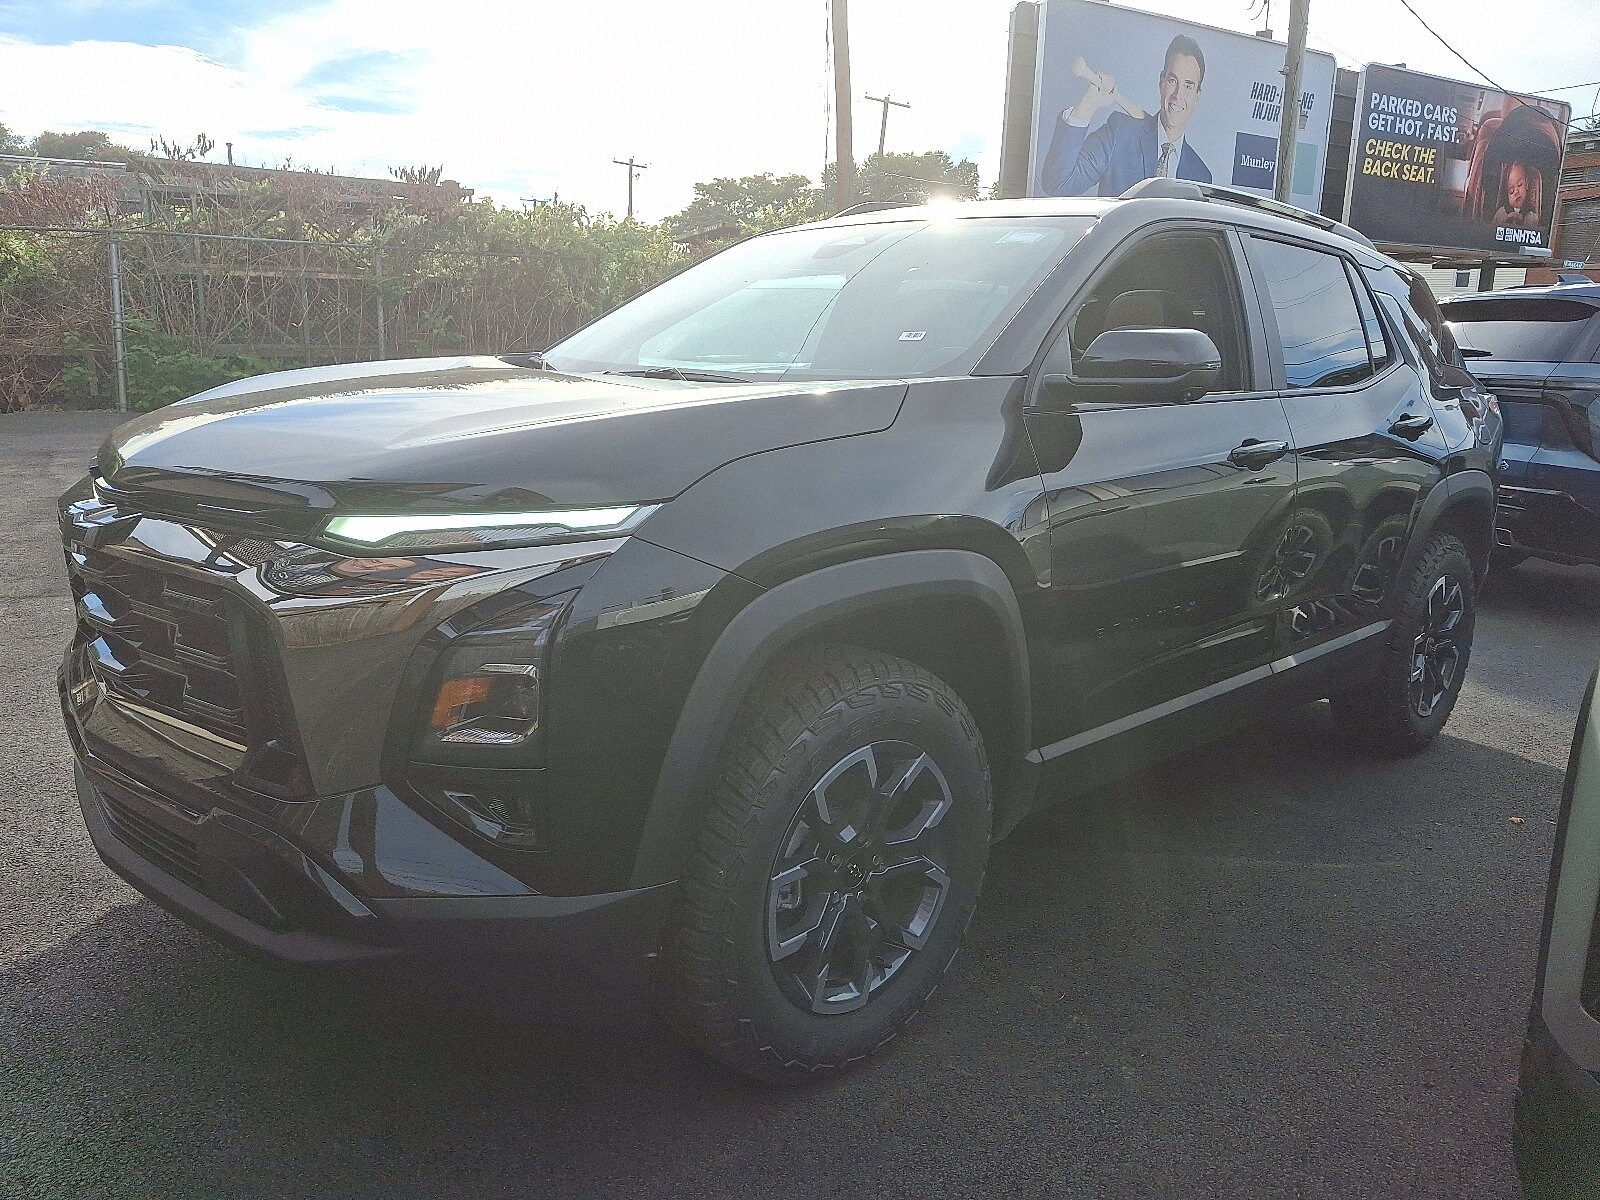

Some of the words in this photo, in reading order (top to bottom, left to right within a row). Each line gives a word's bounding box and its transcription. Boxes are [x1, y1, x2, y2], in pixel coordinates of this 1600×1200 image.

[1252, 101, 1281, 122] INJUR
[1370, 93, 1422, 117] PARKED
[1423, 104, 1458, 124] CARS
[1368, 112, 1396, 132] GET
[1396, 115, 1424, 142] HOT,
[1427, 123, 1460, 143] FAST.
[1240, 154, 1276, 172] Munley
[1365, 138, 1410, 161] CHECK
[1413, 146, 1437, 164] THE
[1362, 158, 1401, 179] BACK
[1402, 164, 1436, 184] SEAT.
[1513, 229, 1542, 245] NHTSA
